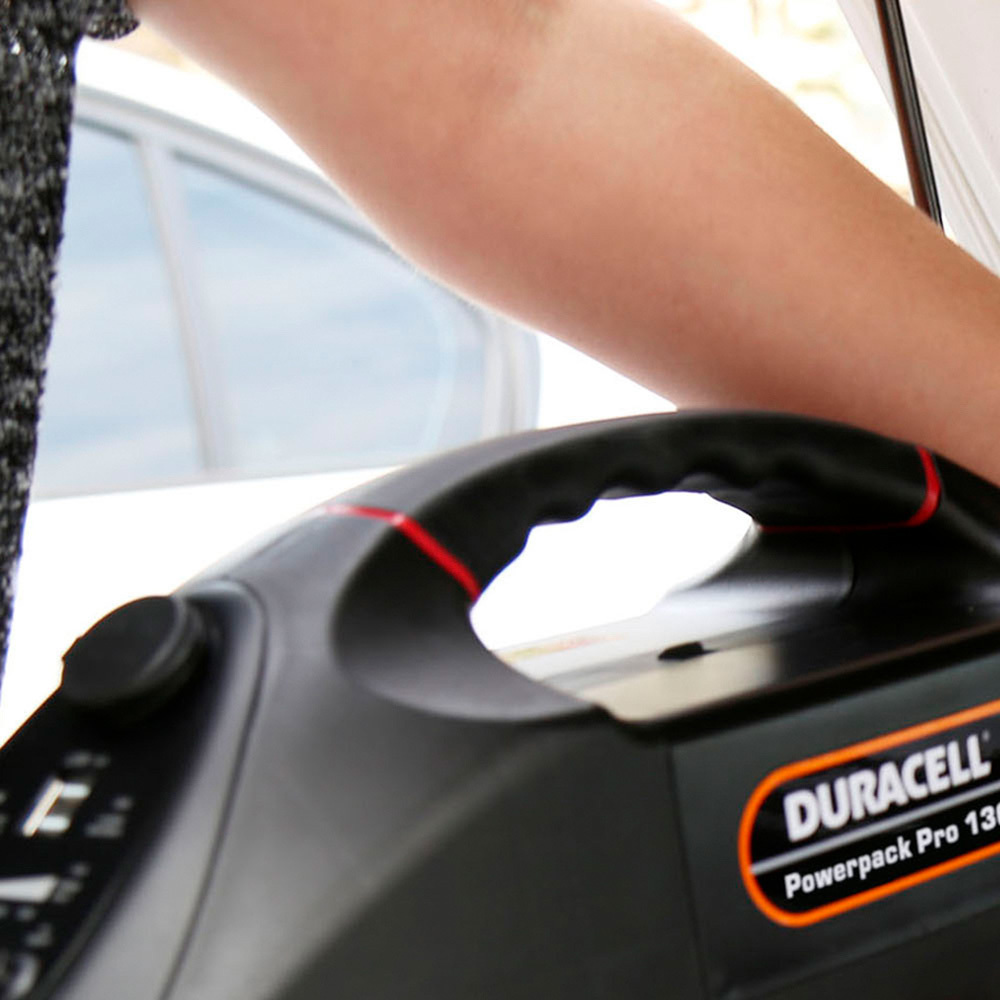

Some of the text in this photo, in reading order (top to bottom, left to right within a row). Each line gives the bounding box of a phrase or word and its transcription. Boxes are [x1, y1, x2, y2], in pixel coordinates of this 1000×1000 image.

[783, 734, 992, 843] DURACELL
[784, 836, 913, 899] Powerpack
[916, 826, 960, 854] Pro
